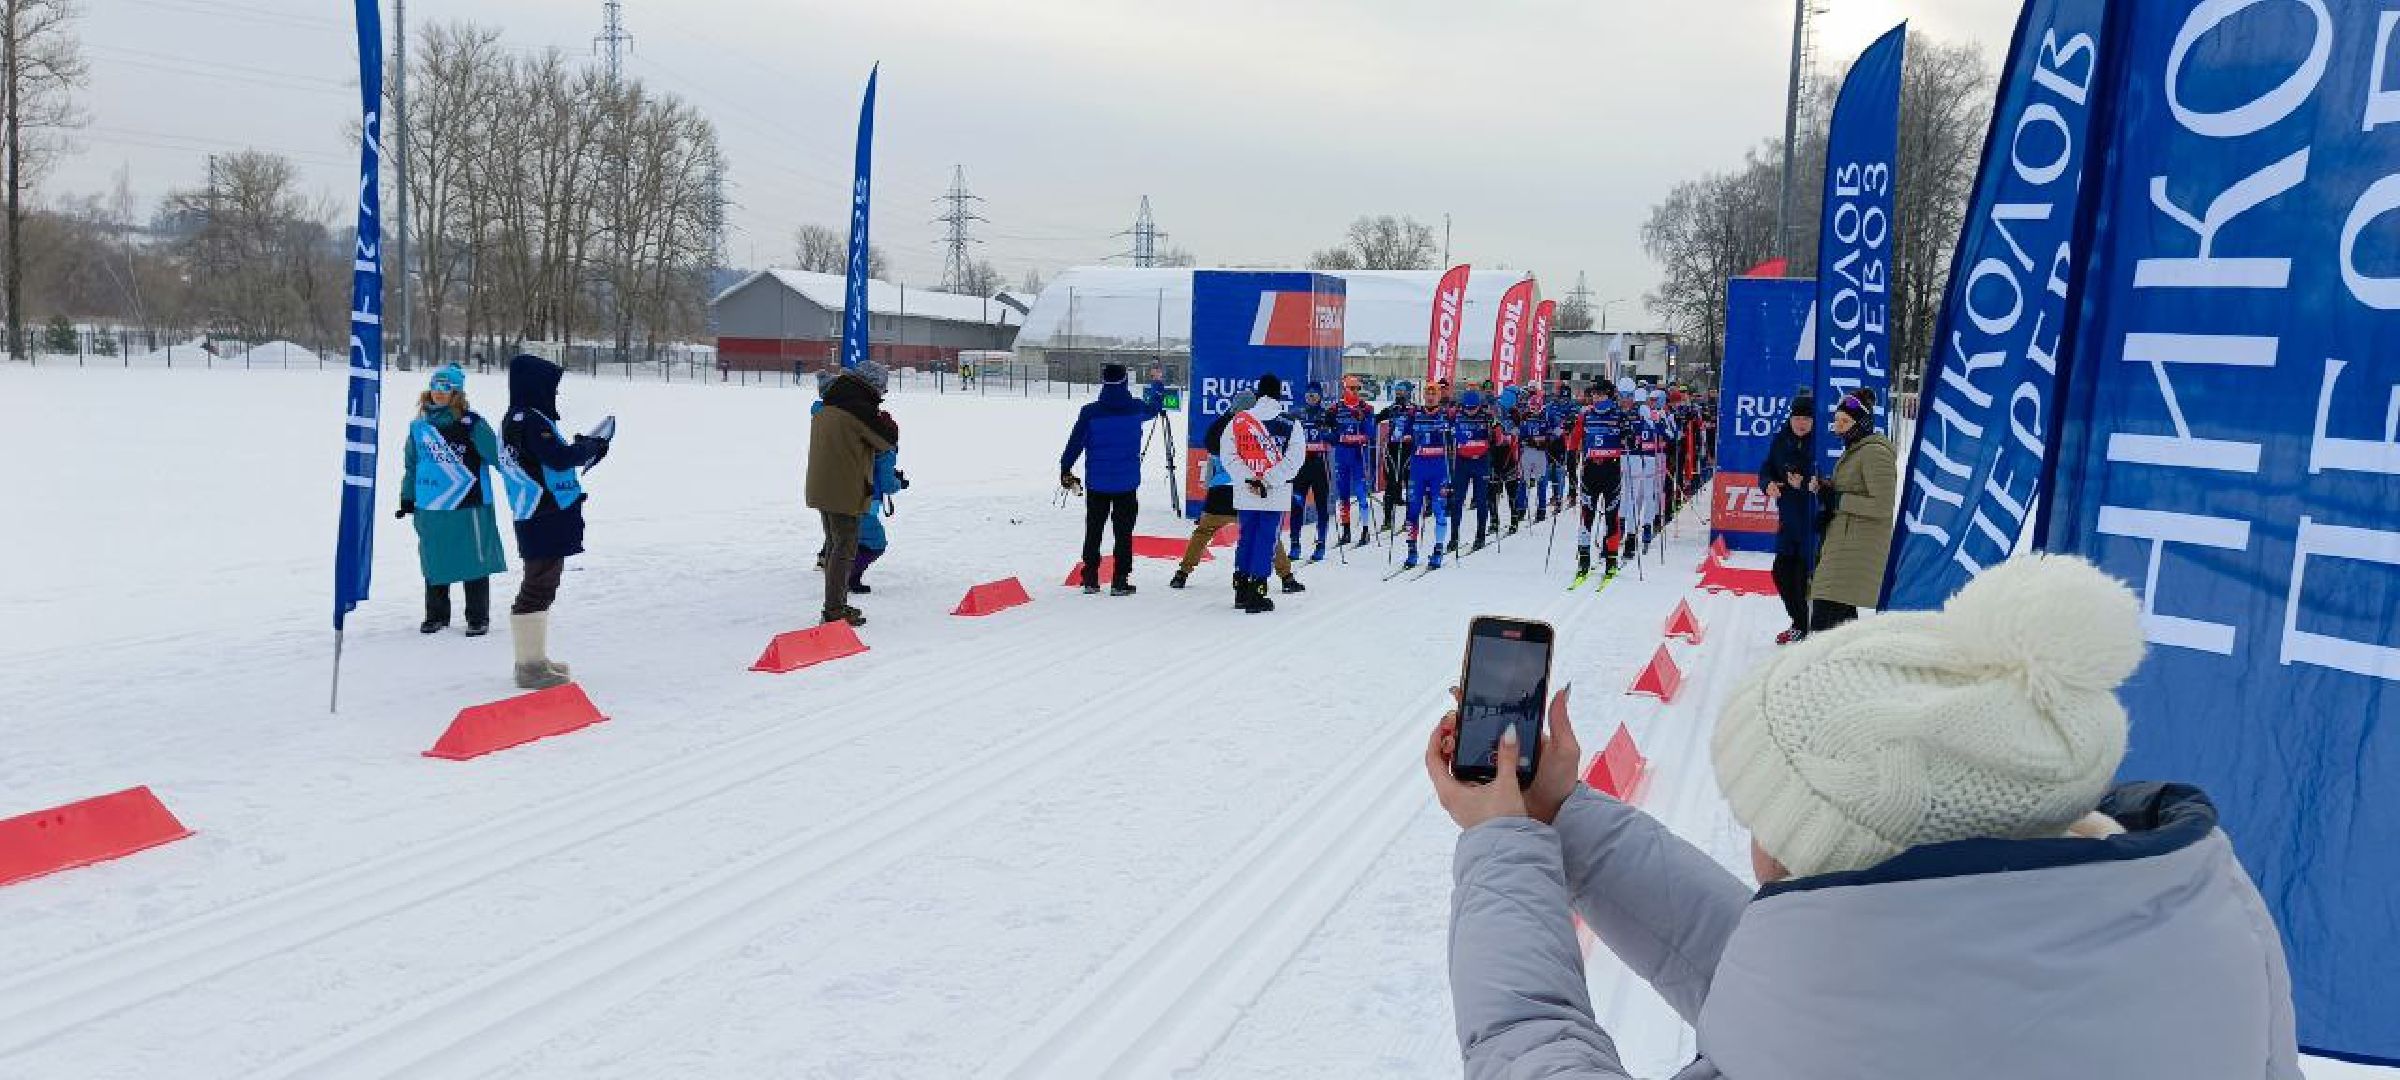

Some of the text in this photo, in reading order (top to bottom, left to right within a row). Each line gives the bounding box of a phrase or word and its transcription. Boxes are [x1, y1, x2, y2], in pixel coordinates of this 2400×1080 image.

[1594, 435, 1604, 447] 5
[1906, 27, 2095, 548] НИКОЛОВ
[2097, 0, 2333, 655] НИКО
